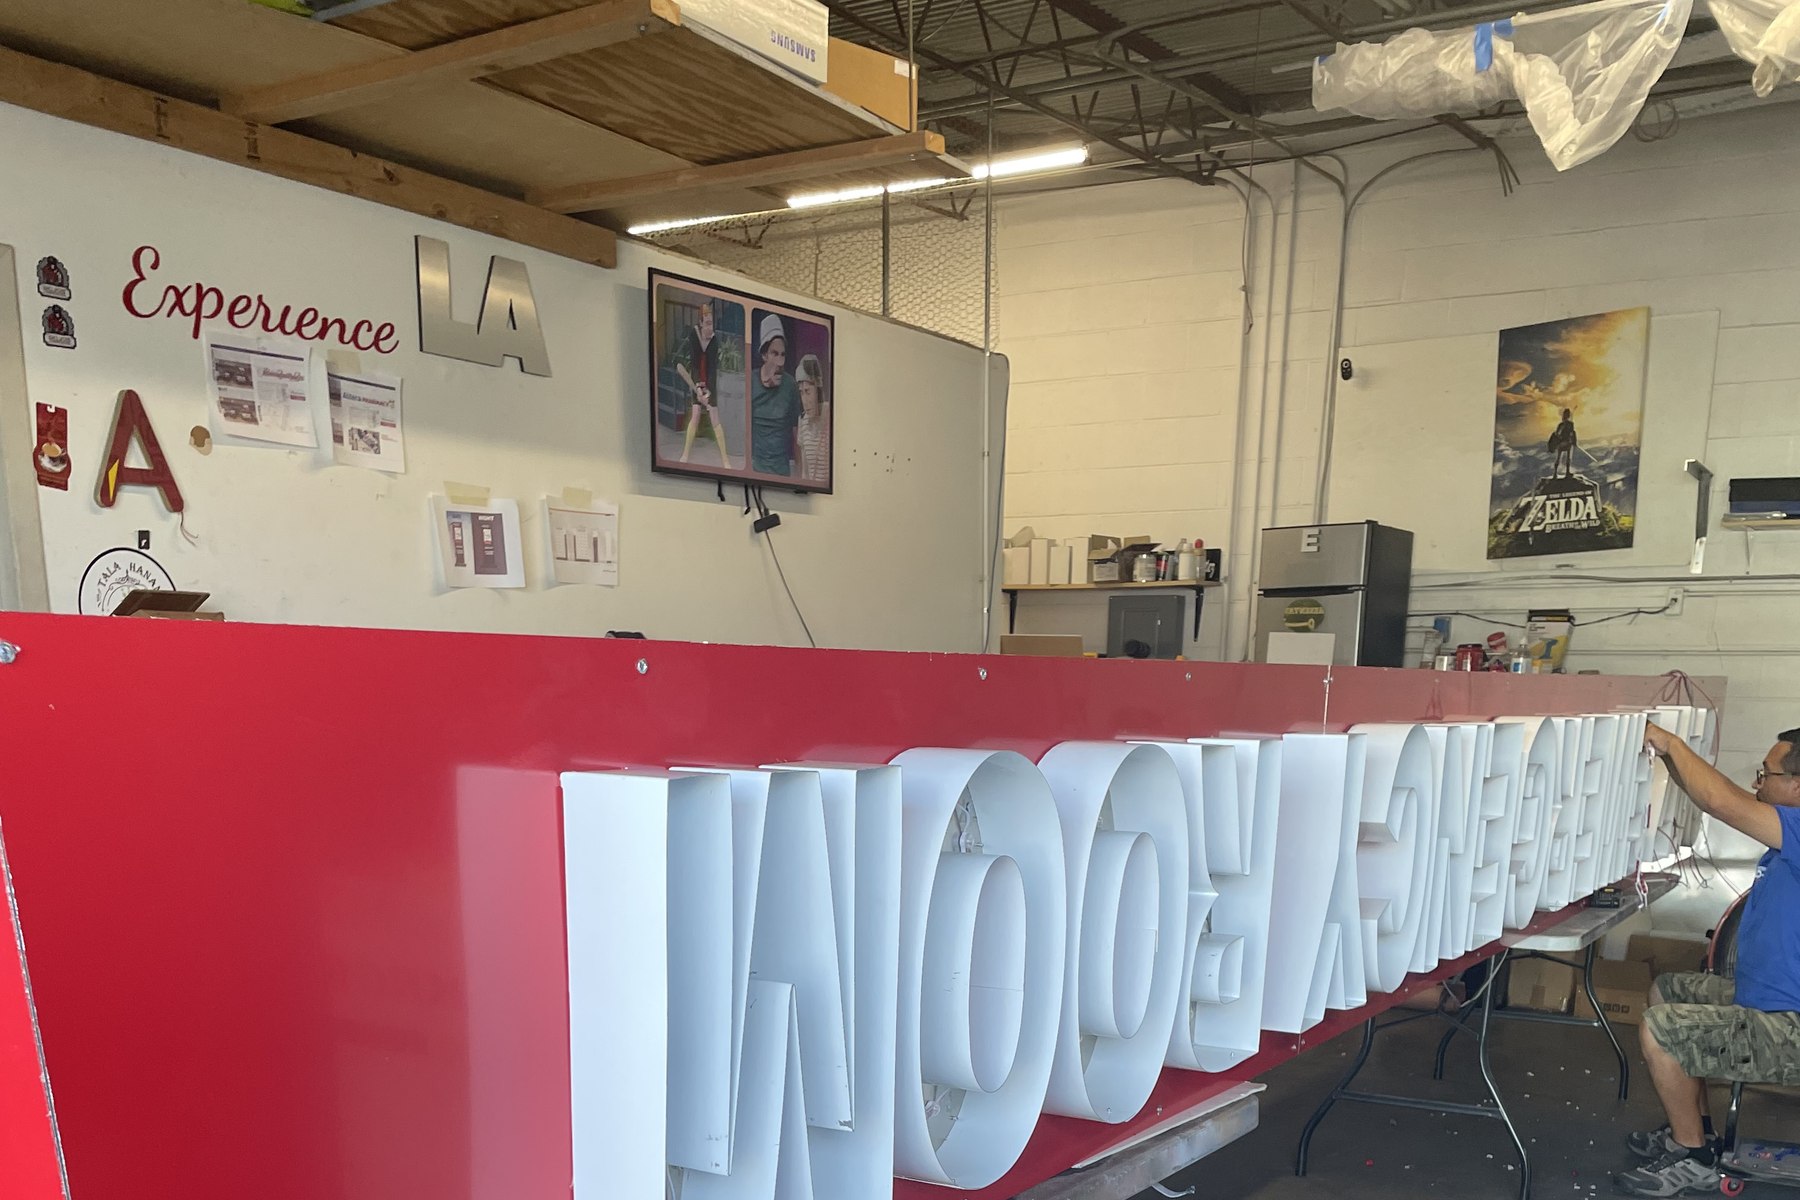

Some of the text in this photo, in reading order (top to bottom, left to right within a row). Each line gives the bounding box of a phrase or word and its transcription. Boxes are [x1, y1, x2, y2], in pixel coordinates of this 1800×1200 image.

[770, 30, 816, 63] SAMSUNG
[122, 245, 399, 354] Experience
[413, 234, 552, 377] LA
[94, 389, 184, 514] A
[1518, 495, 1600, 533] ZELDA
[1301, 527, 1321, 553] E
[97, 561, 122, 588] TALA
